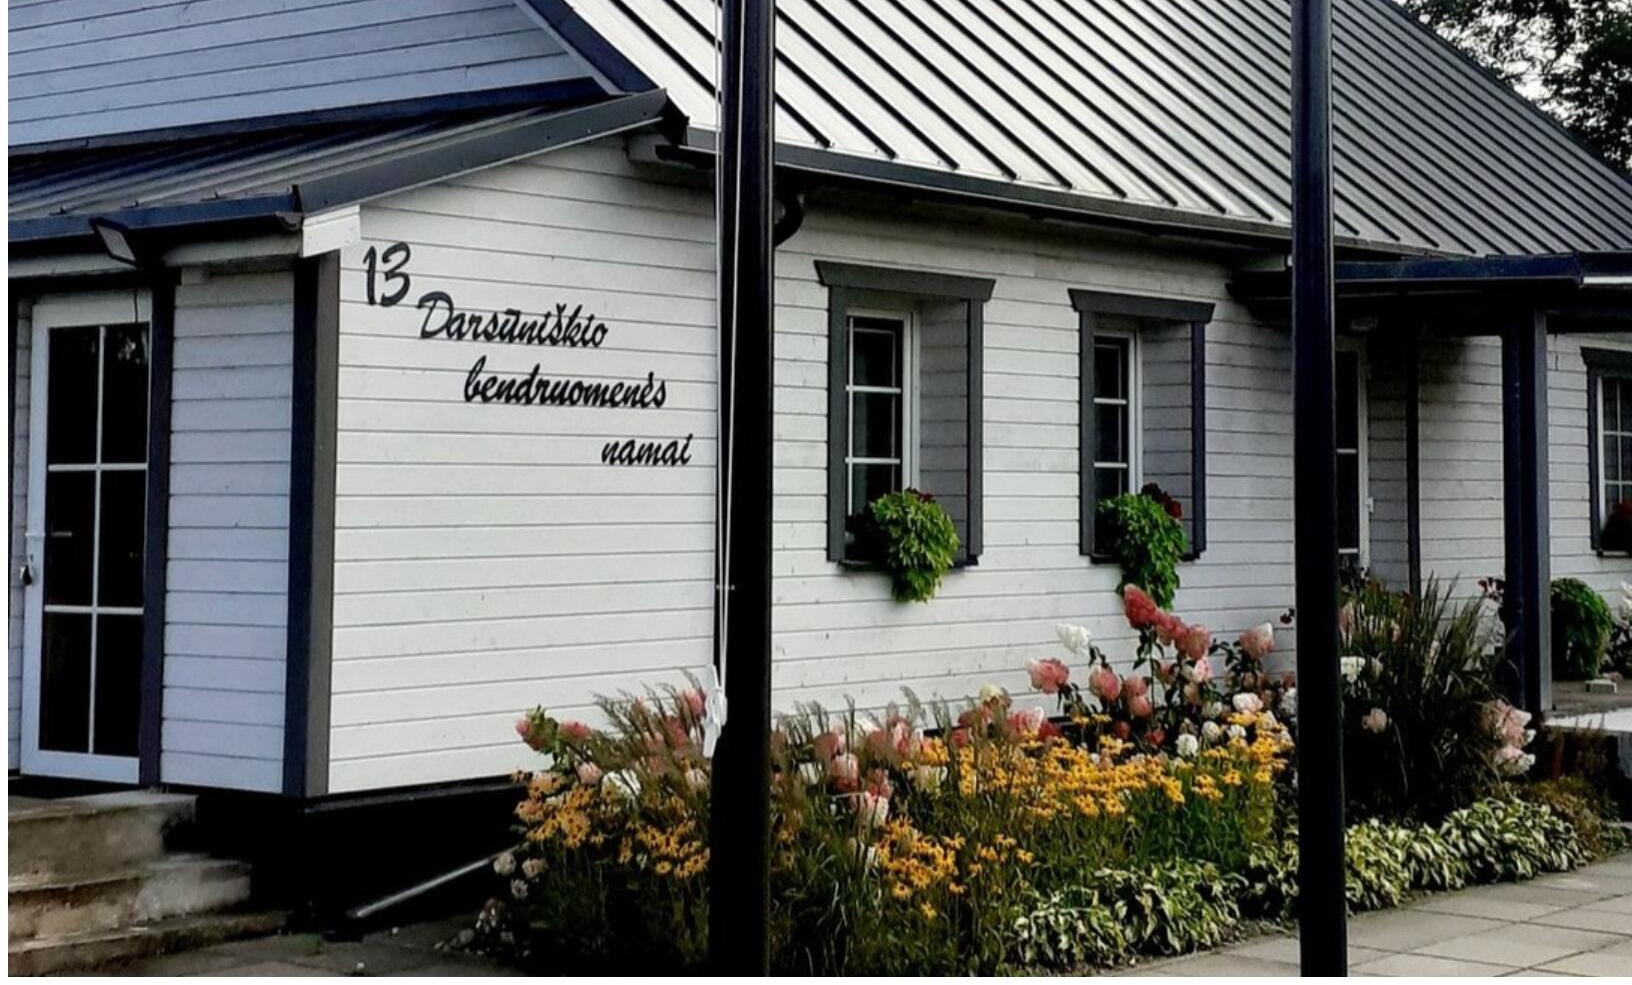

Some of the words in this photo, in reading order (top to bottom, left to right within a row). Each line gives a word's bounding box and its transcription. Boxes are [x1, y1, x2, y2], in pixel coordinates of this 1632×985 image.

[363, 242, 411, 307] 13
[416, 291, 608, 348] Darsūniškio
[463, 355, 667, 408] bendruomenės
[600, 433, 693, 466] namai
